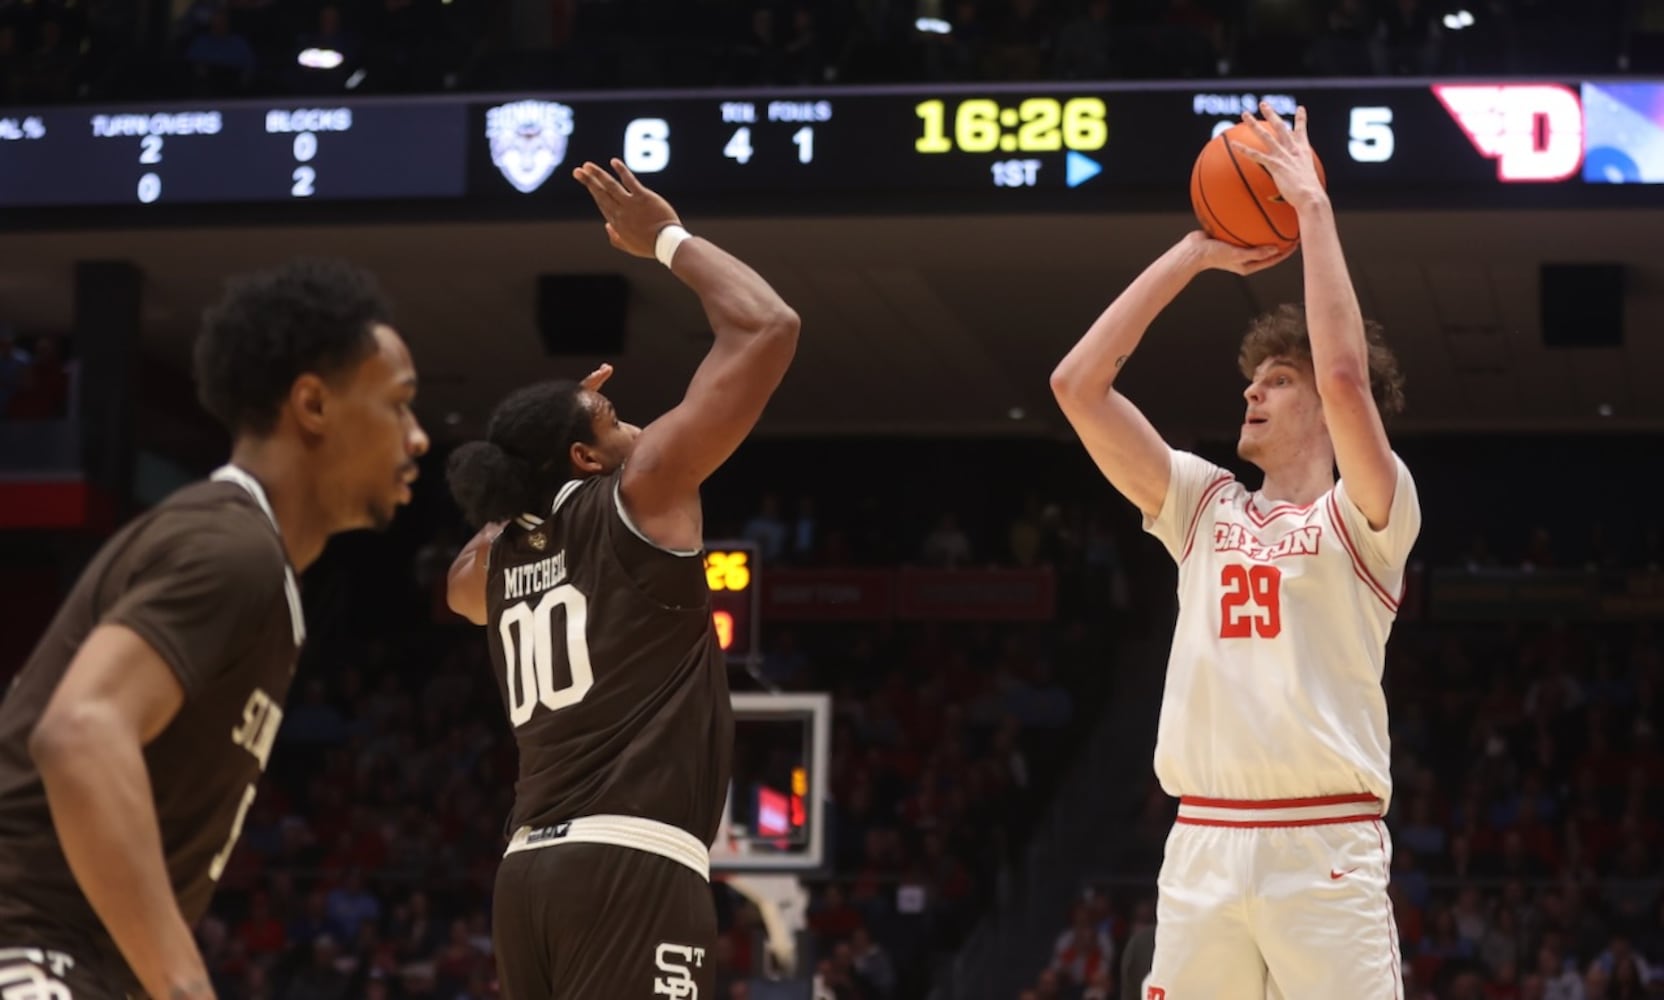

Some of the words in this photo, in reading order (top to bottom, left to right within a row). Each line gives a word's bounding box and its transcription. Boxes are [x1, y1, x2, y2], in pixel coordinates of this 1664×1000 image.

[265, 108, 352, 133] BLOCKS
[768, 100, 832, 122] FOULS
[1193, 94, 1257, 115] FOULS
[91, 111, 222, 138] TURNOVERS
[914, 98, 1108, 153] 16:26
[1348, 107, 1394, 162] 5
[139, 135, 163, 164] 2
[293, 131, 318, 162] 0
[623, 117, 670, 173] 6
[723, 126, 753, 164] 4
[792, 125, 814, 164] 1
[137, 172, 161, 203] 0
[291, 165, 316, 197] 2
[991, 159, 1041, 187] 1ST
[1214, 521, 1322, 562] DAYTON
[504, 549, 567, 600] MITCHELL
[1219, 564, 1281, 638] 29
[499, 583, 594, 728] 00
